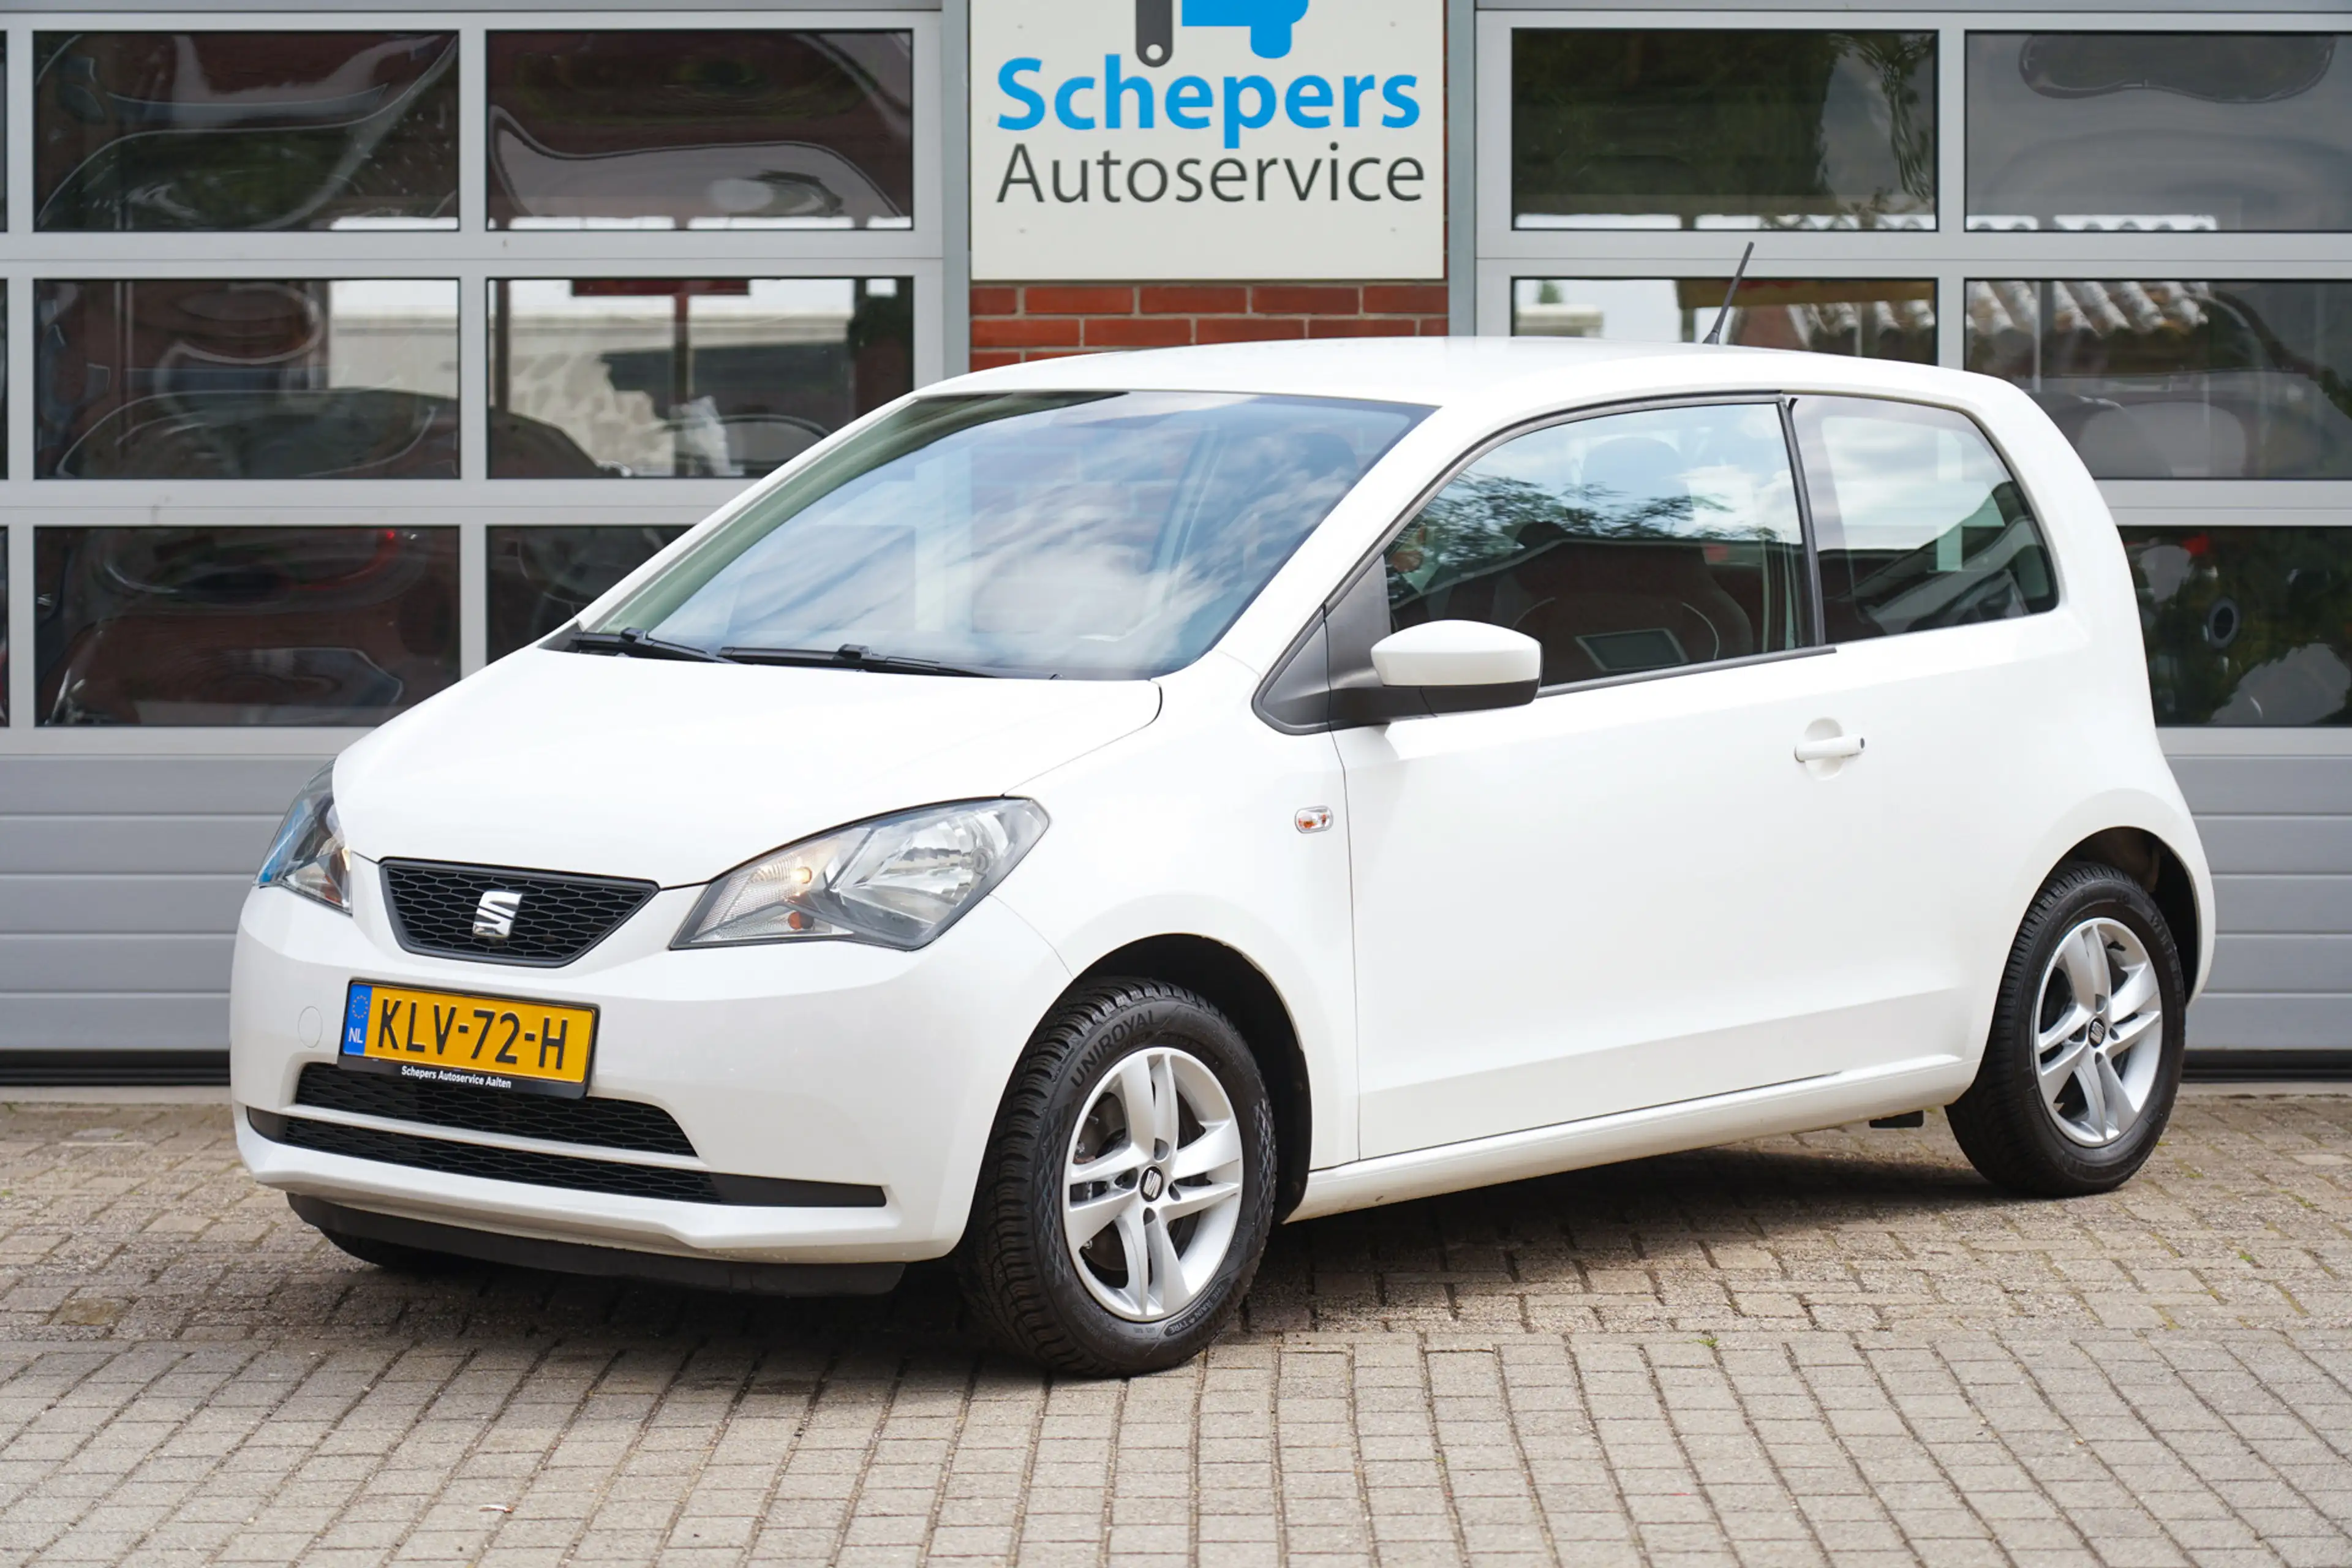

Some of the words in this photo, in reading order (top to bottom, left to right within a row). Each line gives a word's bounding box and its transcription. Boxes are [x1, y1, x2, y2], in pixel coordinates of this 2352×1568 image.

[997, 54, 1420, 149] Schepers
[997, 141, 1424, 203] Autoservice
[349, 1027, 363, 1044] NL
[378, 998, 568, 1070] KLV-72-H
[1070, 1009, 1161, 1088] UNIROYAL
[401, 1065, 437, 1080] Schepers
[438, 1071, 484, 1085] Autoservice
[485, 1077, 511, 1089] Aalten
[1169, 1320, 1189, 1334] TYRE
